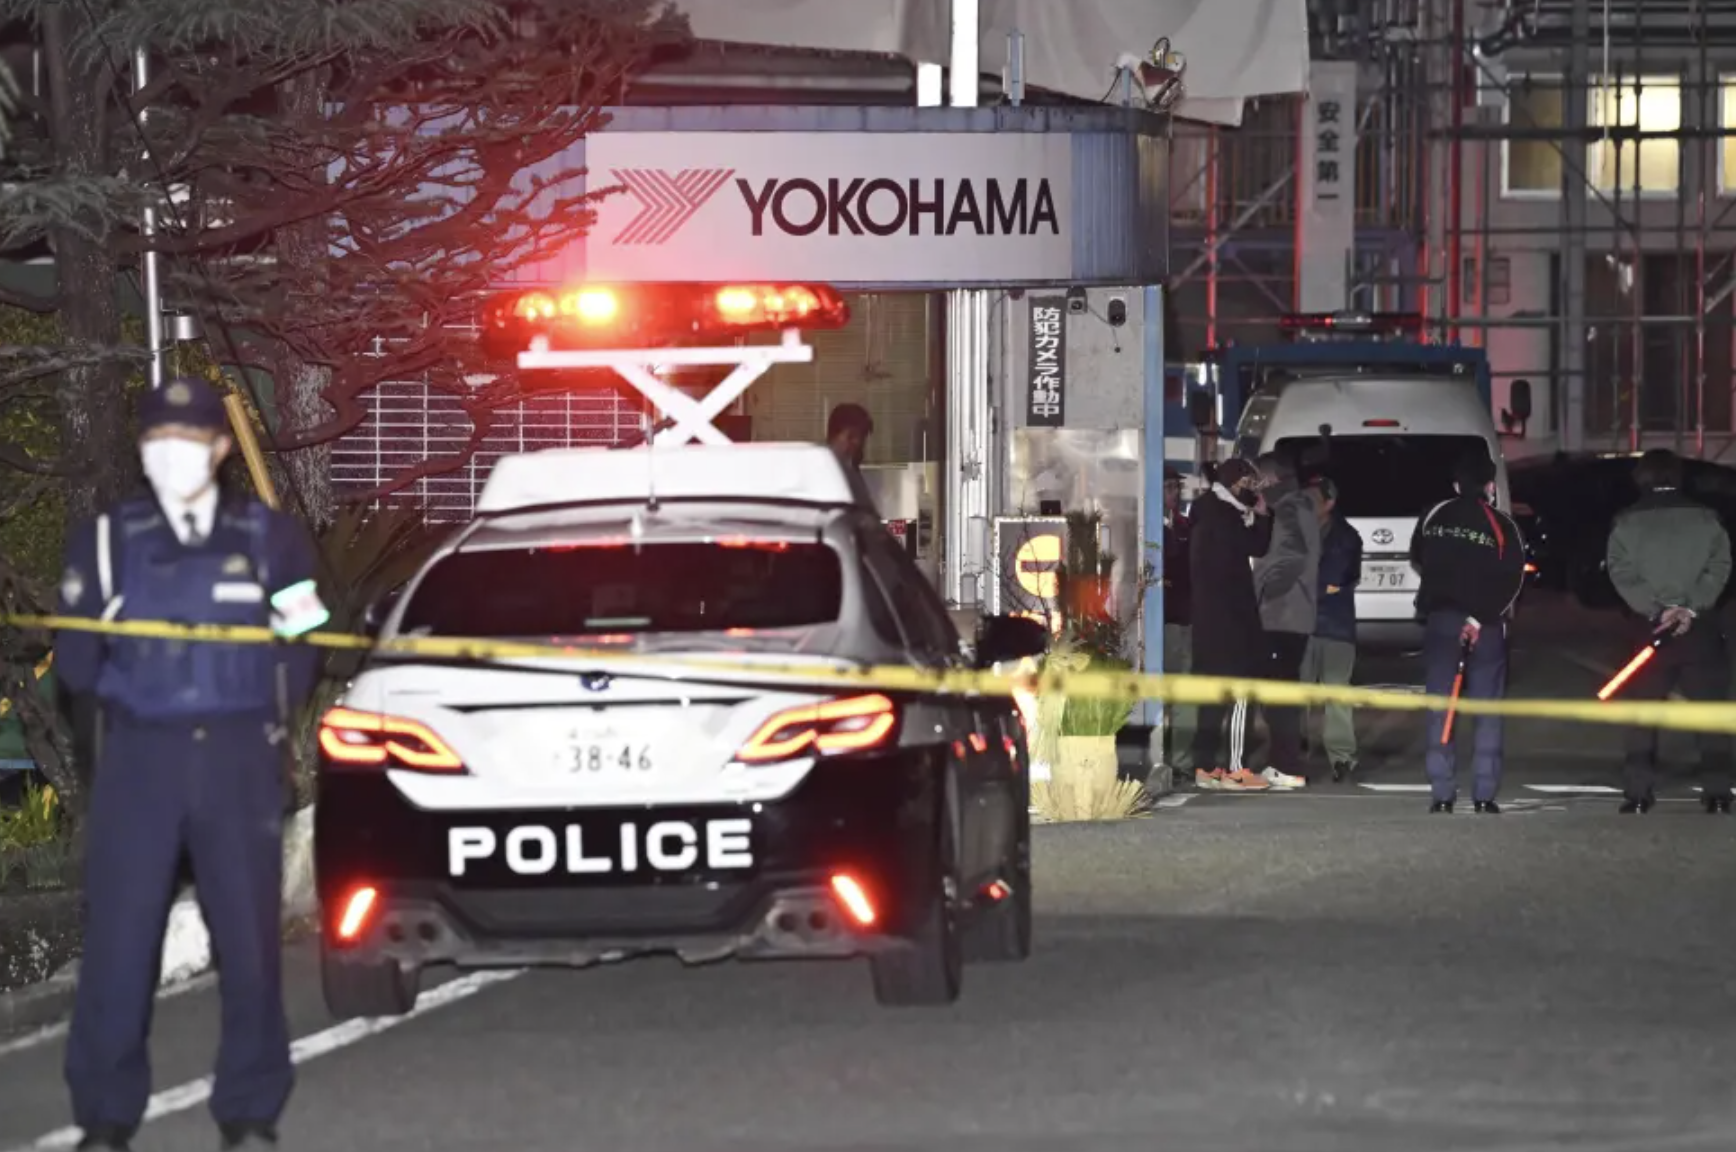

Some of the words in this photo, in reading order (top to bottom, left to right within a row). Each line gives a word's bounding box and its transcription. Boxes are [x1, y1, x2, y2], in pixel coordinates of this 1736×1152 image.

[1317, 100, 1340, 199] 安全第一
[736, 178, 1059, 236] YOKOHAMA
[1032, 307, 1061, 418] 防犯カメラ作動中
[448, 819, 754, 876] POLICE
